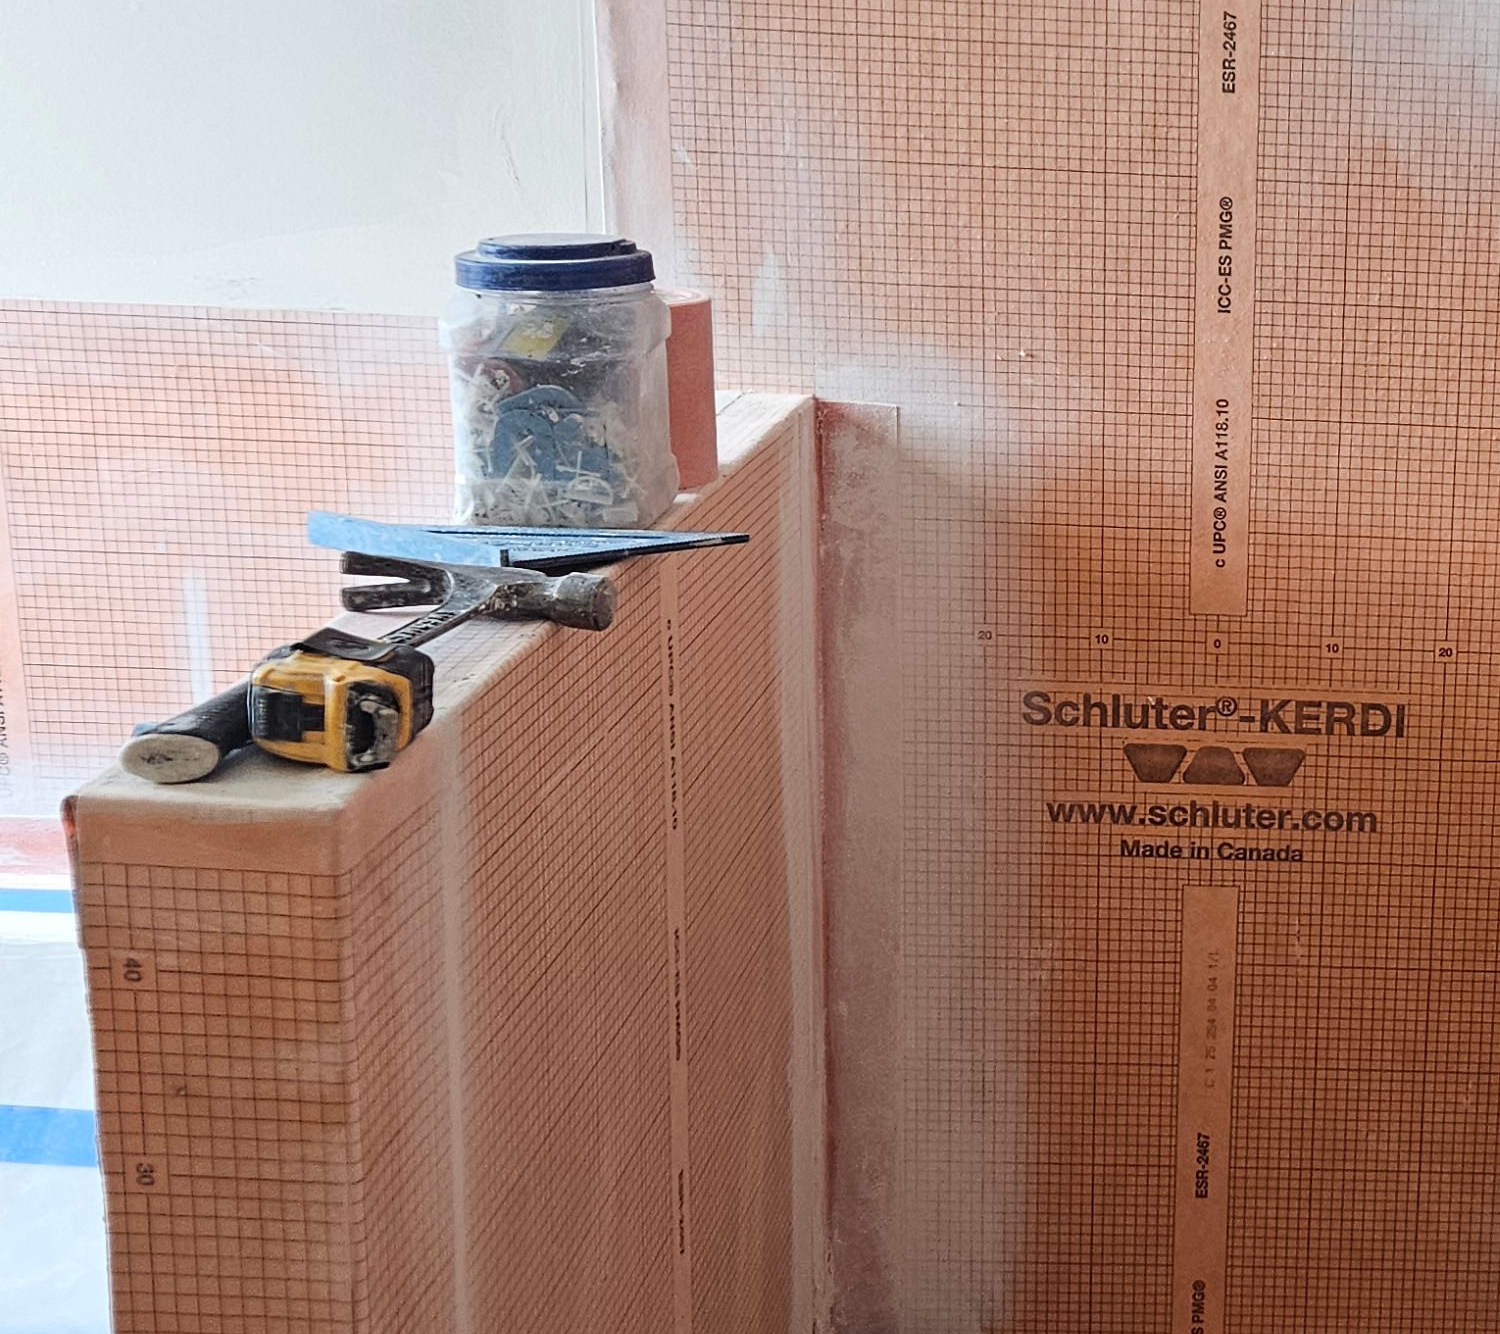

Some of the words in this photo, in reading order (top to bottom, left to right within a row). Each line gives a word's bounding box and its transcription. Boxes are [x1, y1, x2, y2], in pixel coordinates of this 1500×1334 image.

[1221, 11, 1237, 94] ESR-2467
[1218, 256, 1232, 314] ICC-ES
[1214, 398, 1229, 460] A118.10
[1214, 462, 1228, 504] ANSI
[978, 631, 993, 640] 20
[1095, 634, 1109, 644] 10
[1213, 638, 1222, 649] 0
[1326, 643, 1340, 653] 10
[1439, 647, 1454, 658] 20
[1021, 690, 1407, 739] Schluter®-KERDI
[1046, 800, 1379, 835] www.schluter.com
[1120, 840, 1183, 859] Made
[1190, 842, 1209, 860] in
[1216, 842, 1304, 863] Canada
[124, 958, 143, 982] 40
[135, 1163, 155, 1187] 30
[1195, 1132, 1211, 1199] ESR-2467
